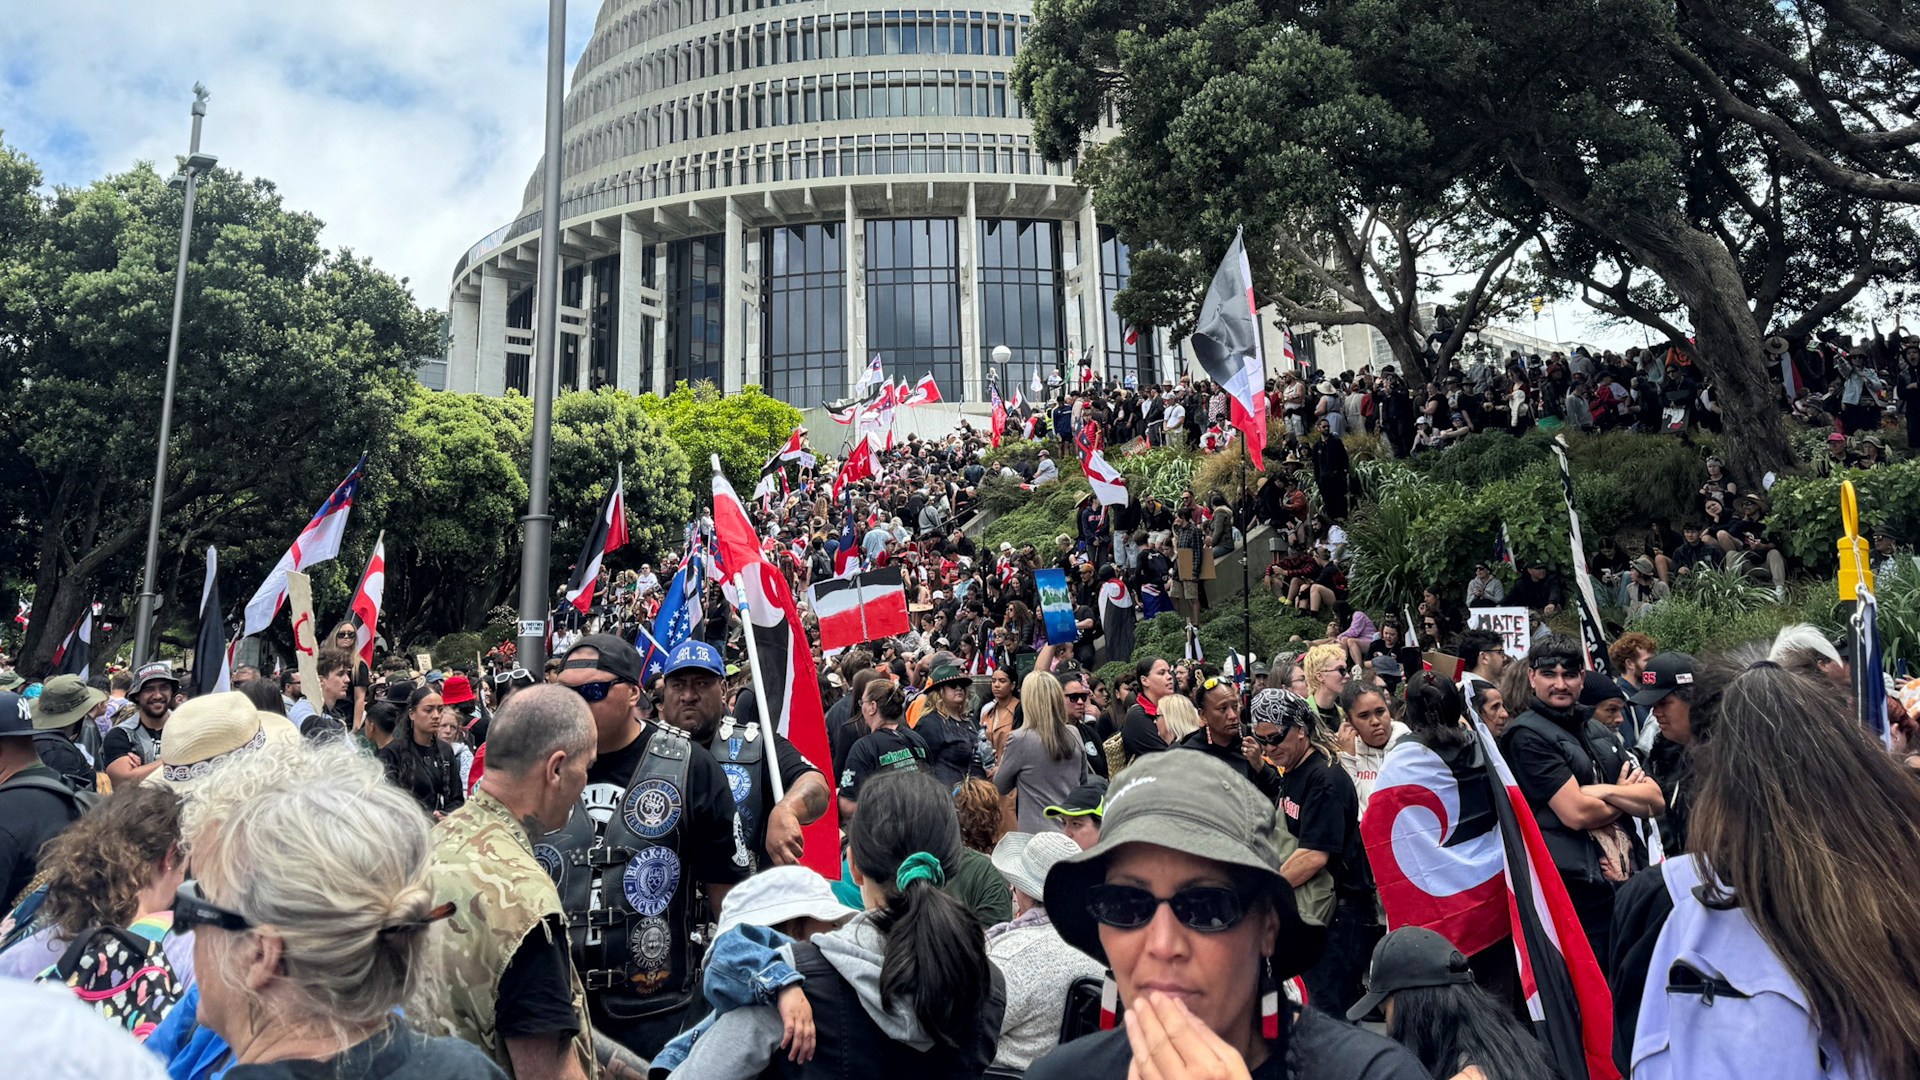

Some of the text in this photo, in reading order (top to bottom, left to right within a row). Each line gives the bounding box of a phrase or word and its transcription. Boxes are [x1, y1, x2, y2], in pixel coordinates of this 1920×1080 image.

[1478, 613, 1524, 631] MATE
[656, 781, 678, 801] KAHA
[627, 847, 679, 877] BLACK POWER
[627, 891, 673, 914] AUCKLAND
